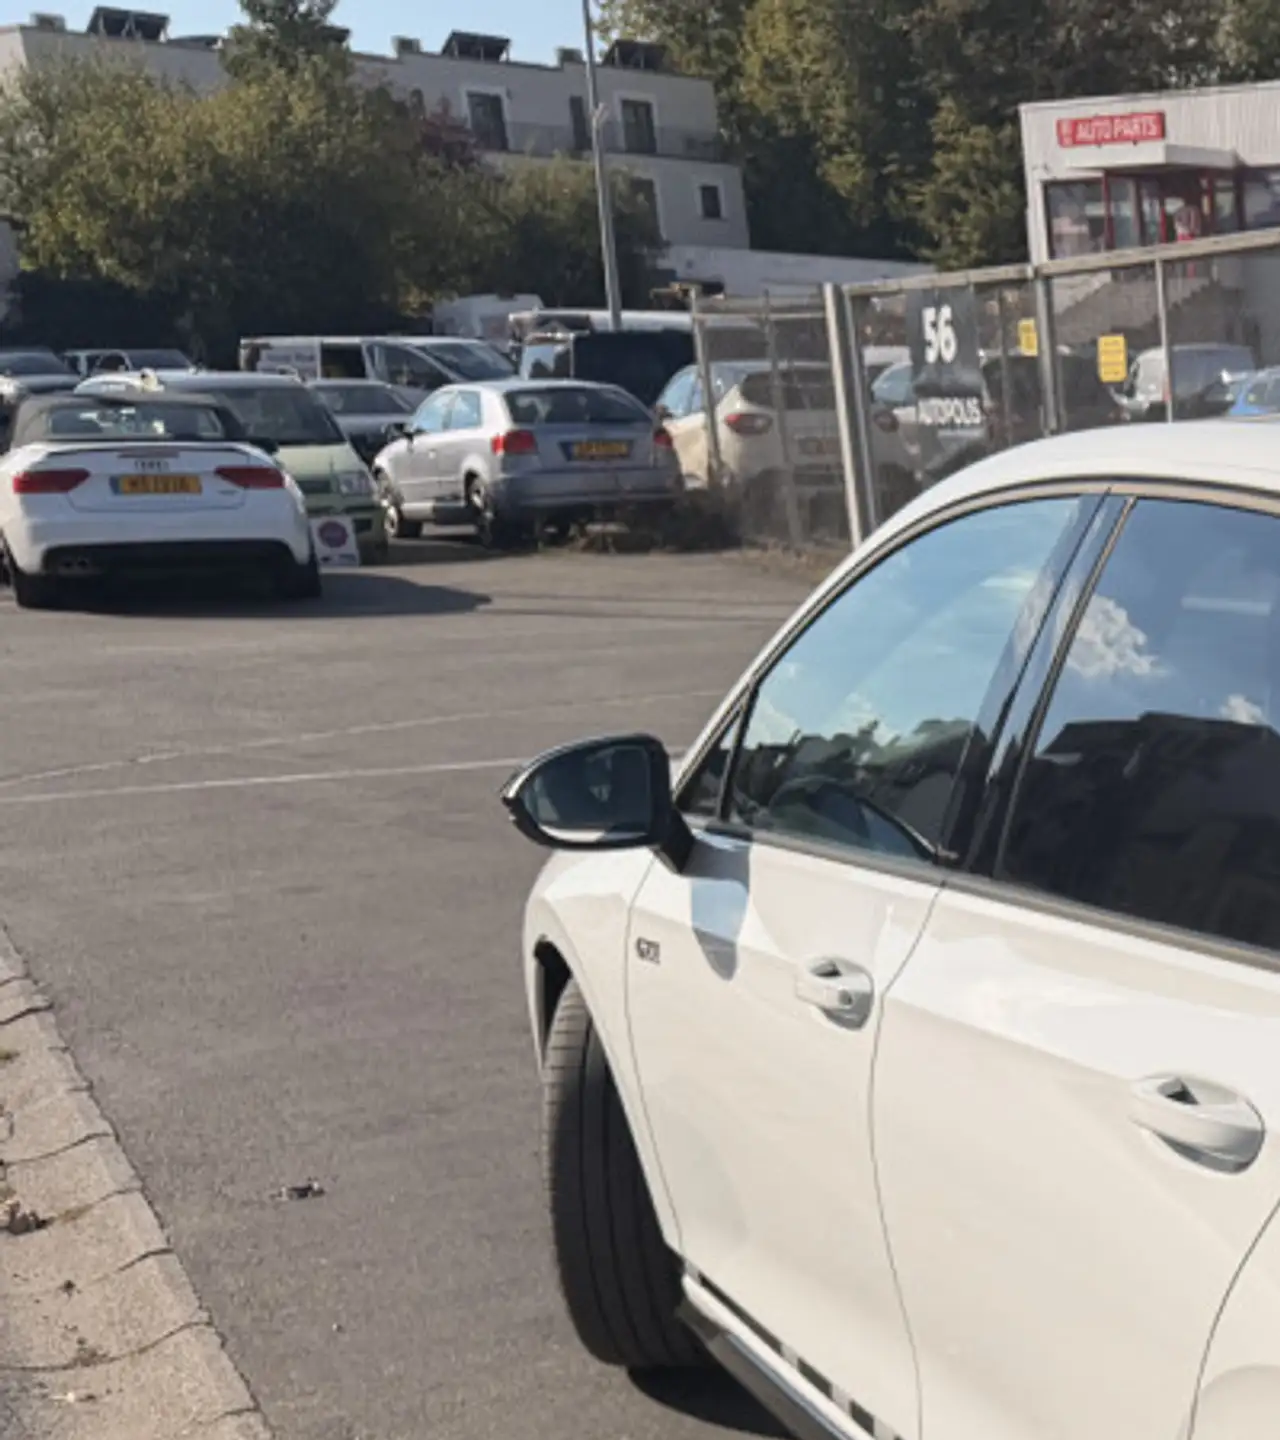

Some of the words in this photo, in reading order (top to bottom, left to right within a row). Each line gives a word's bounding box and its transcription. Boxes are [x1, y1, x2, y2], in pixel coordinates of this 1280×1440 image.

[1075, 118, 1111, 142] AUTO
[1113, 115, 1158, 139] PARTS
[921, 303, 957, 364] 56
